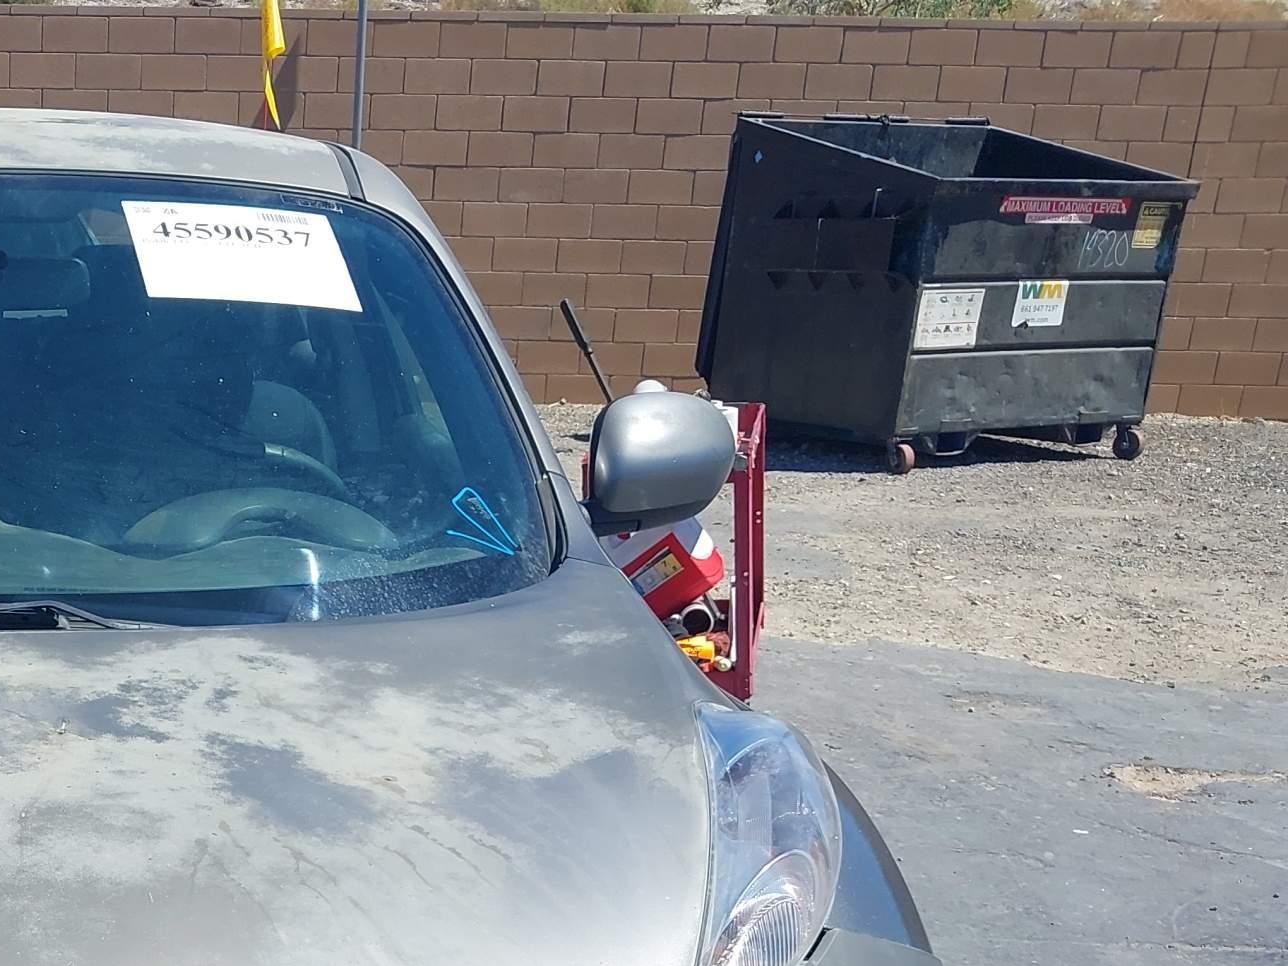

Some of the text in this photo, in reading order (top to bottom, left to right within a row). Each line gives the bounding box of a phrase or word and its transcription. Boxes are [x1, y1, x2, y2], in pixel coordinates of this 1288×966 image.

[1006, 200, 1123, 213] MAXIMUM LOADING LEVEL
[153, 221, 310, 248] 45590537
[1022, 283, 1064, 299] WM
